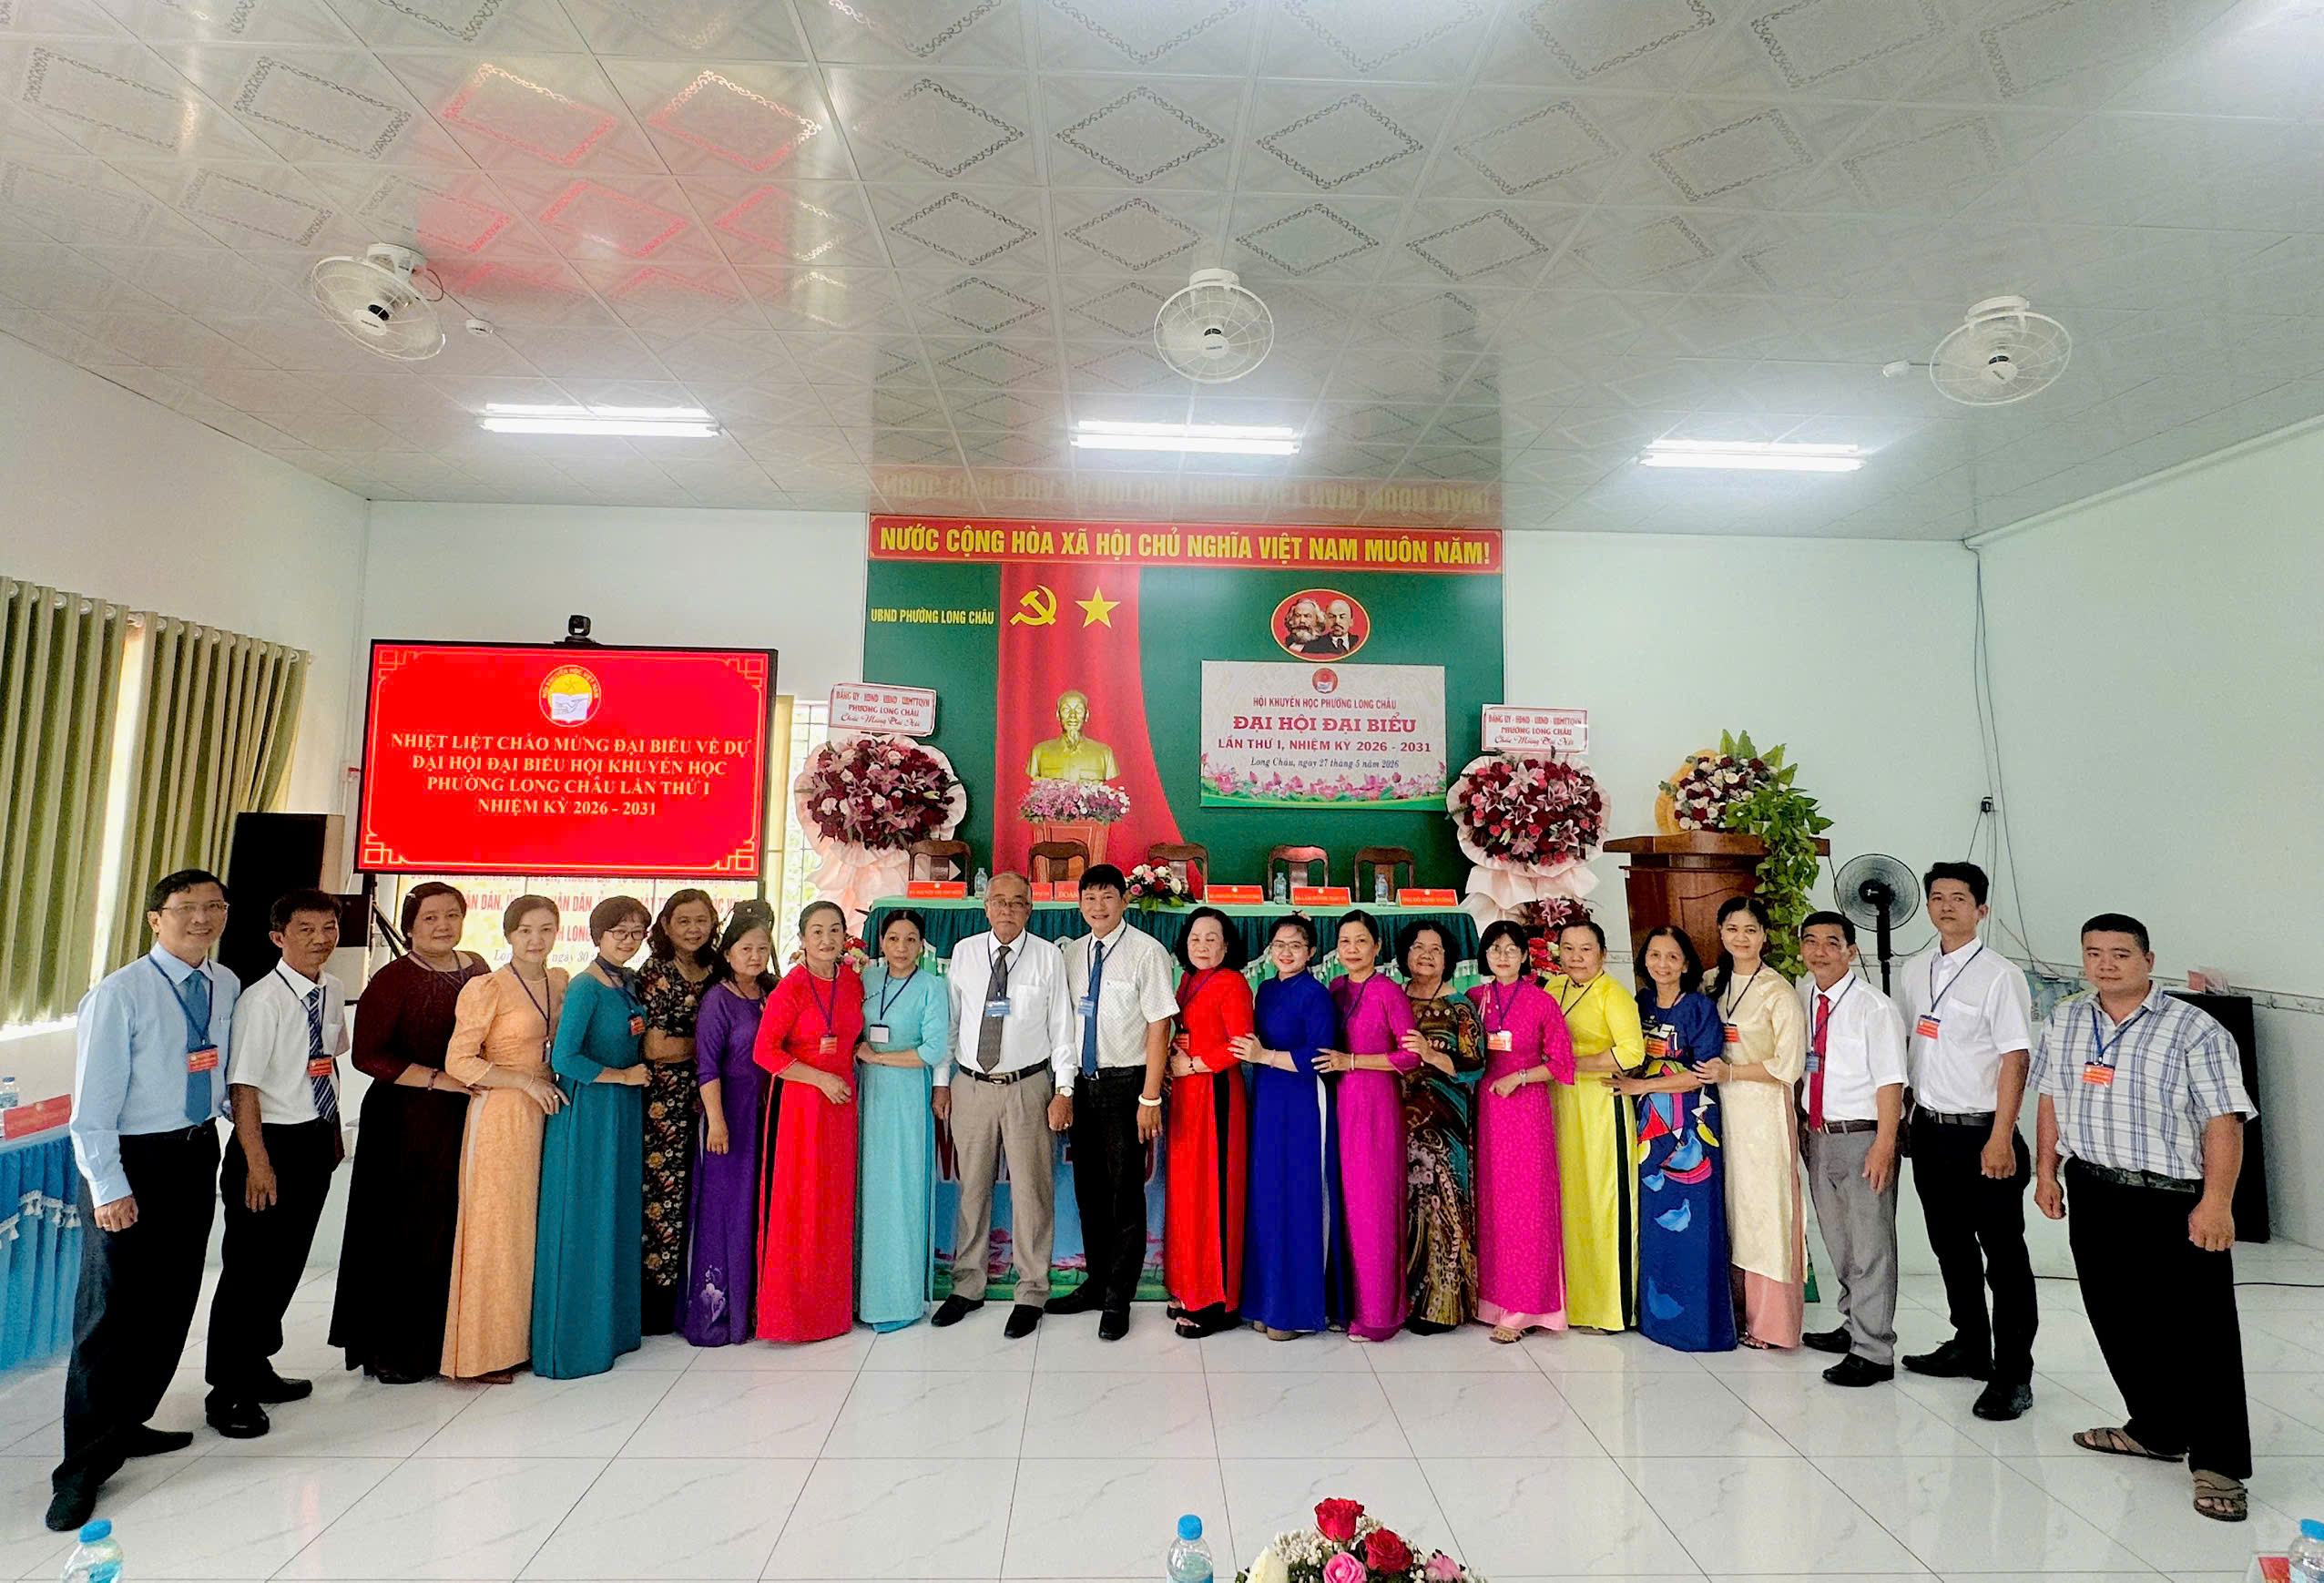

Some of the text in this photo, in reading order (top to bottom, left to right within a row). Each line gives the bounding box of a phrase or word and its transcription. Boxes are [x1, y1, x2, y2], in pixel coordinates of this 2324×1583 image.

[881, 526, 1490, 565] NƯỚC CỘNG HÒA XÃ HỘI CHỦ NGHĨA VIỆT NAM MUÔN NĂM!
[871, 607, 994, 625] UBND PHƯỜNG LONG CHÂU
[848, 704, 920, 717] PHƯỜNG LONG CHÂU
[1253, 694, 1397, 710] HỘI KHUYẾN HỌC PHƯỜNG LONG CHÂU
[1233, 711, 1416, 734] ĐẠI HỘI ĐẠI BIỂU
[392, 733, 753, 758] NHIỆT LIỆT CHÀO MỪNG ĐẠI BIỂU VỀ DỰ
[1218, 734, 1244, 749] LẦN
[1248, 737, 1274, 750] THỨ
[1278, 740, 1285, 752] I,
[1289, 738, 1330, 752] NHIỆM
[1356, 741, 1388, 751] 2026
[1401, 741, 1432, 752] 2031
[413, 755, 728, 778] ĐẠI HỘI ĐẠI BIỂU HỘI KHUYẾN HỌC
[1250, 757, 1400, 770] Long Châu, ngày 27 tháng 5 năm 2026
[427, 774, 709, 795] PHƯỜNG LONG CHÂU LẦN THỨ I
[477, 798, 537, 816] NHIỆM
[544, 797, 568, 813] KỲ
[574, 801, 607, 815] 2026
[622, 802, 656, 815] 2031
